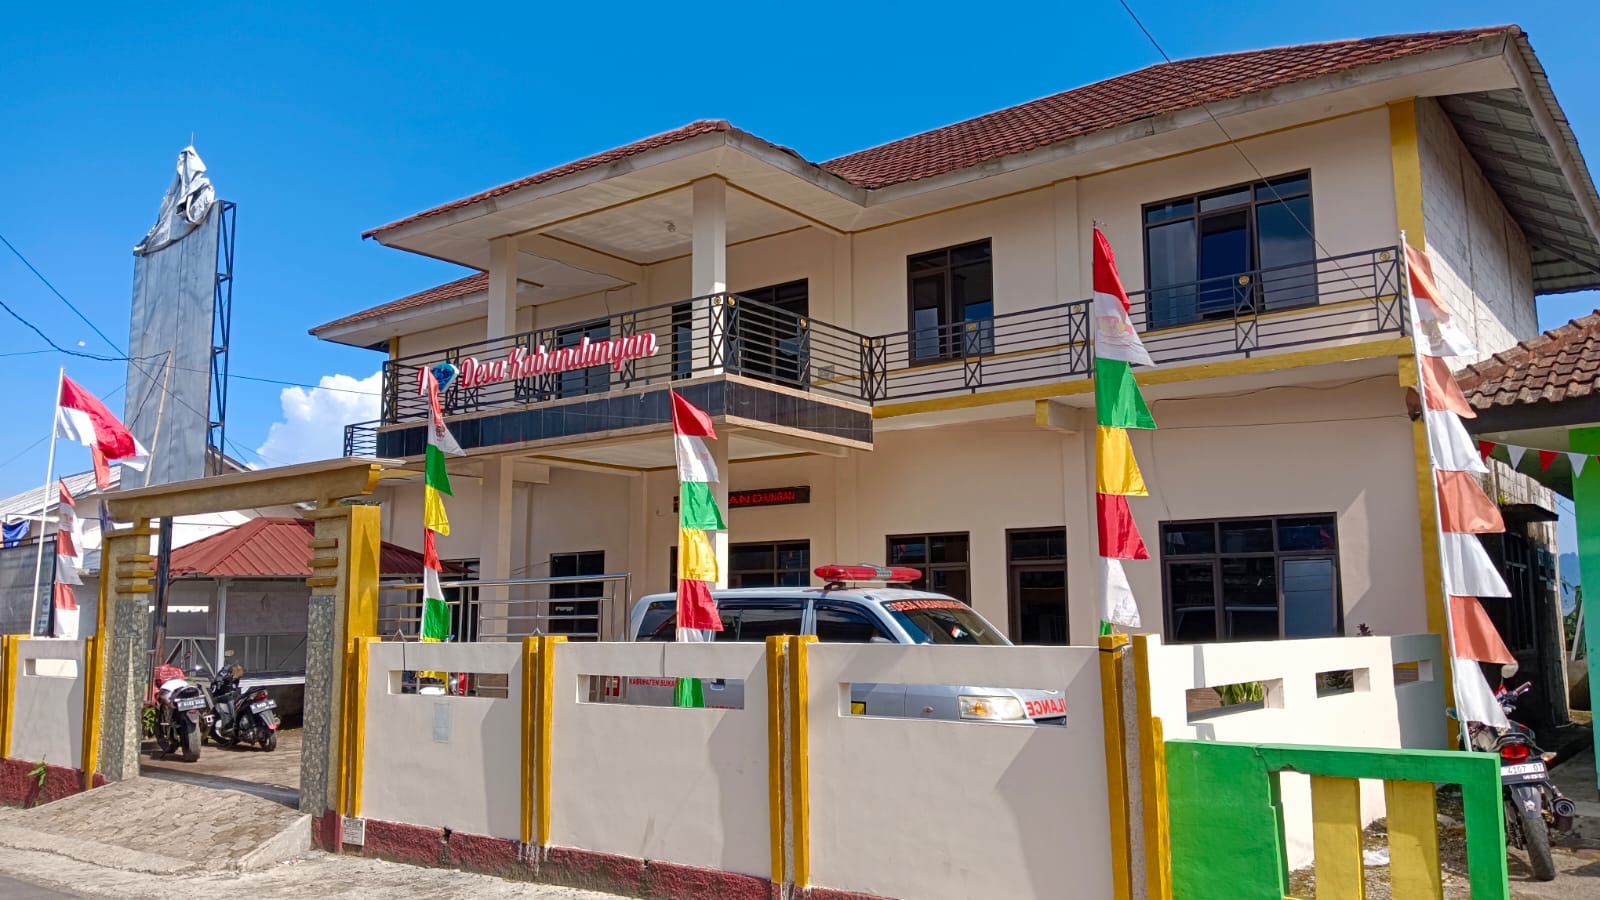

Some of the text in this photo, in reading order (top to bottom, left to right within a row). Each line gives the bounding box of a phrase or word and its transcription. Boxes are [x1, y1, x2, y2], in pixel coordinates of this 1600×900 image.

[461, 357, 506, 387] Desa
[507, 333, 658, 380] Kabandungan
[728, 491, 797, 505] ANDUNGAN
[891, 600, 917, 612] DESA
[660, 679, 675, 687] SUKA
